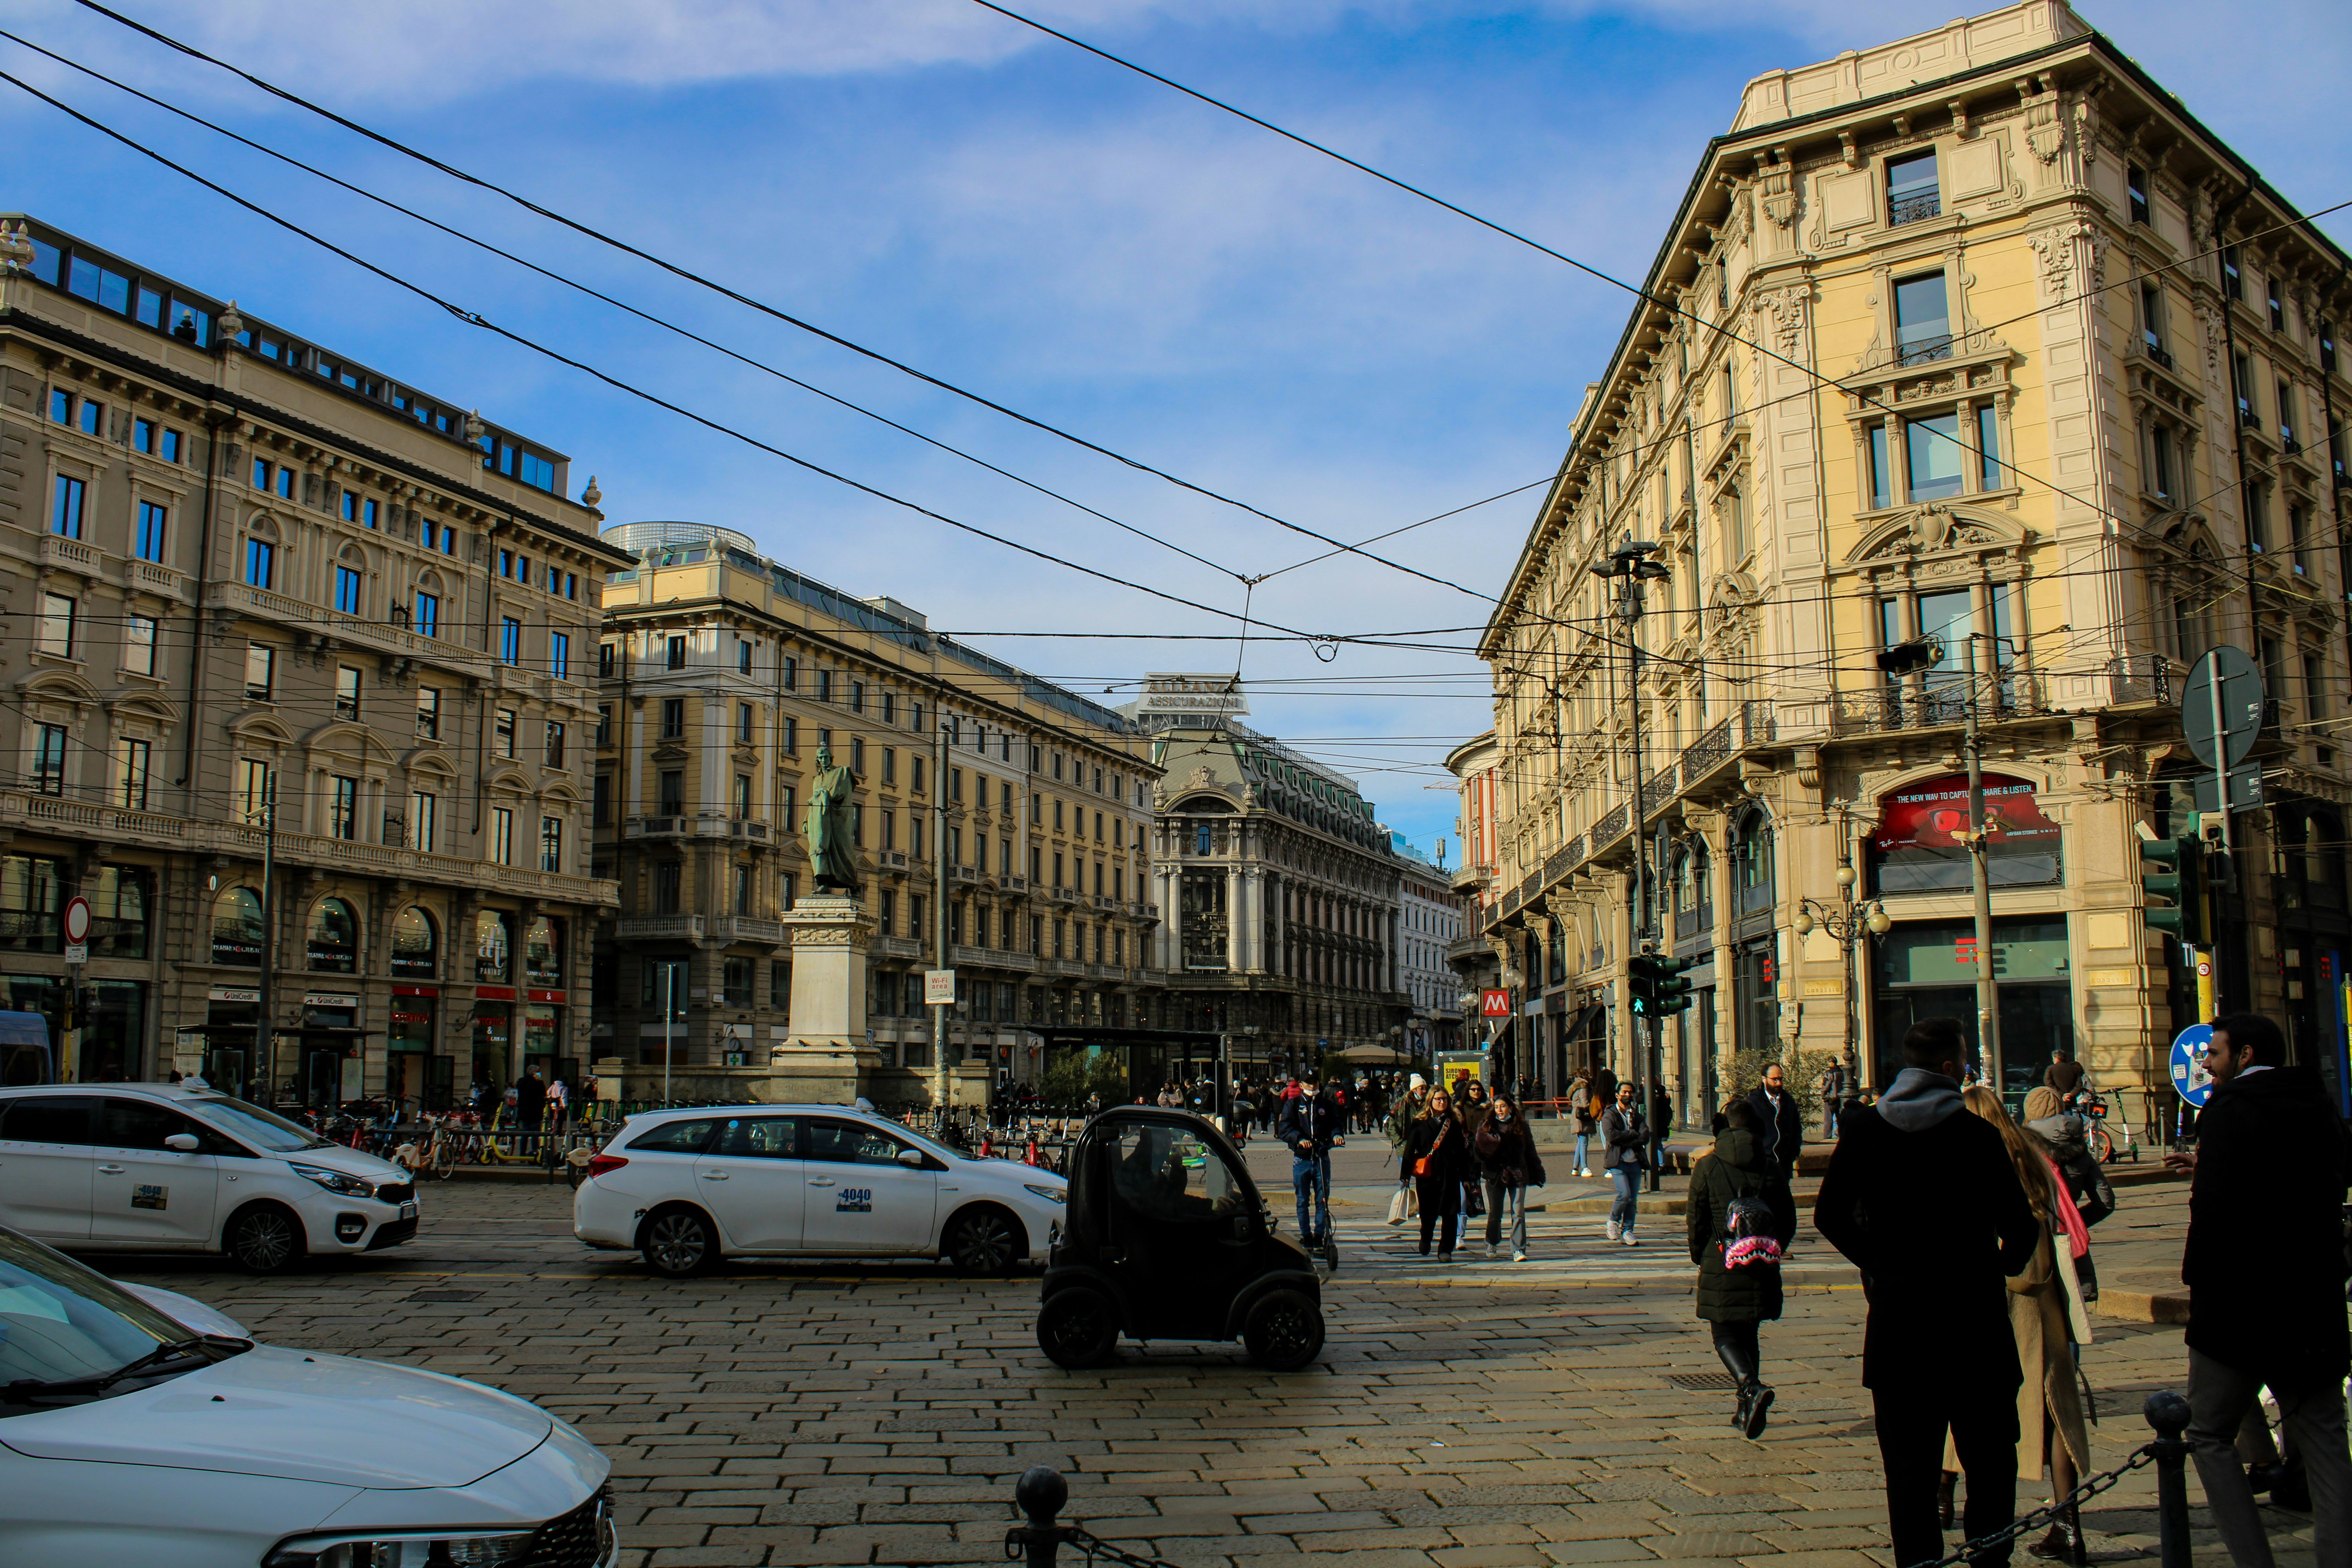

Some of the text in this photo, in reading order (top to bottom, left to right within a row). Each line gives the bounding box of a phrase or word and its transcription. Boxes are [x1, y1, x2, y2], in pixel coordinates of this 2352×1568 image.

[1147, 681, 1238, 694] ALLEANZ
[1147, 696, 1238, 707] ASSICURAZIONI
[1897, 795, 1909, 803] THE
[1910, 793, 1924, 802] NEW
[1925, 792, 1938, 801] WAY
[1940, 791, 1948, 800] TO
[1949, 790, 1969, 799] CAPTU
[2003, 787, 2008, 795] &
[2009, 785, 2033, 794] LISTEN.
[480, 967, 501, 976] PANINO
[1484, 995, 1507, 1011] M
[526, 1017, 557, 1028] amamay
[843, 1188, 871, 1204] 4040
